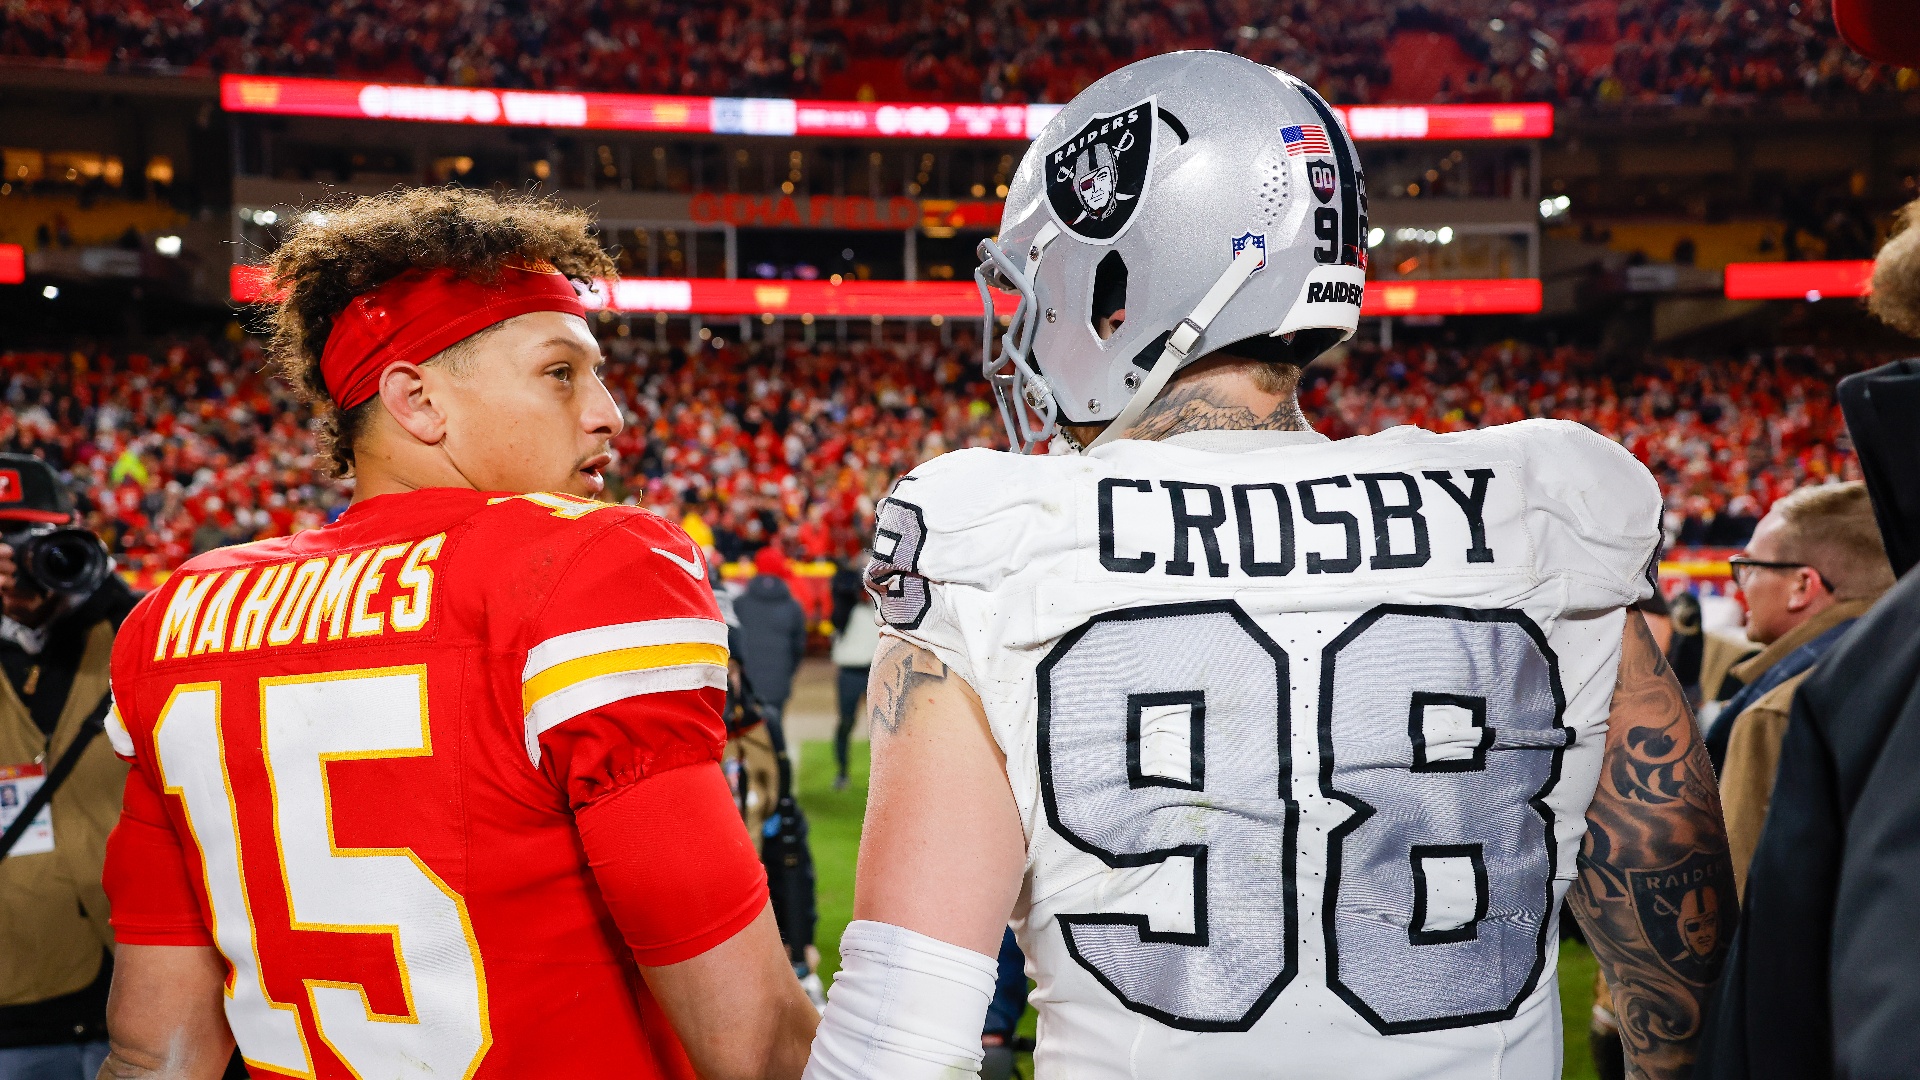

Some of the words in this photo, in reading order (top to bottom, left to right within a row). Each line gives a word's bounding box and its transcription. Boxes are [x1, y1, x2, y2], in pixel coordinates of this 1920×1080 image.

[1054, 109, 1139, 165] RAIDERS
[807, 194, 919, 231] FIELD
[1097, 469, 1495, 578] CROSBY
[153, 531, 448, 662] MAHOMES
[151, 662, 494, 1080] 15
[1036, 599, 1577, 1036] 98
